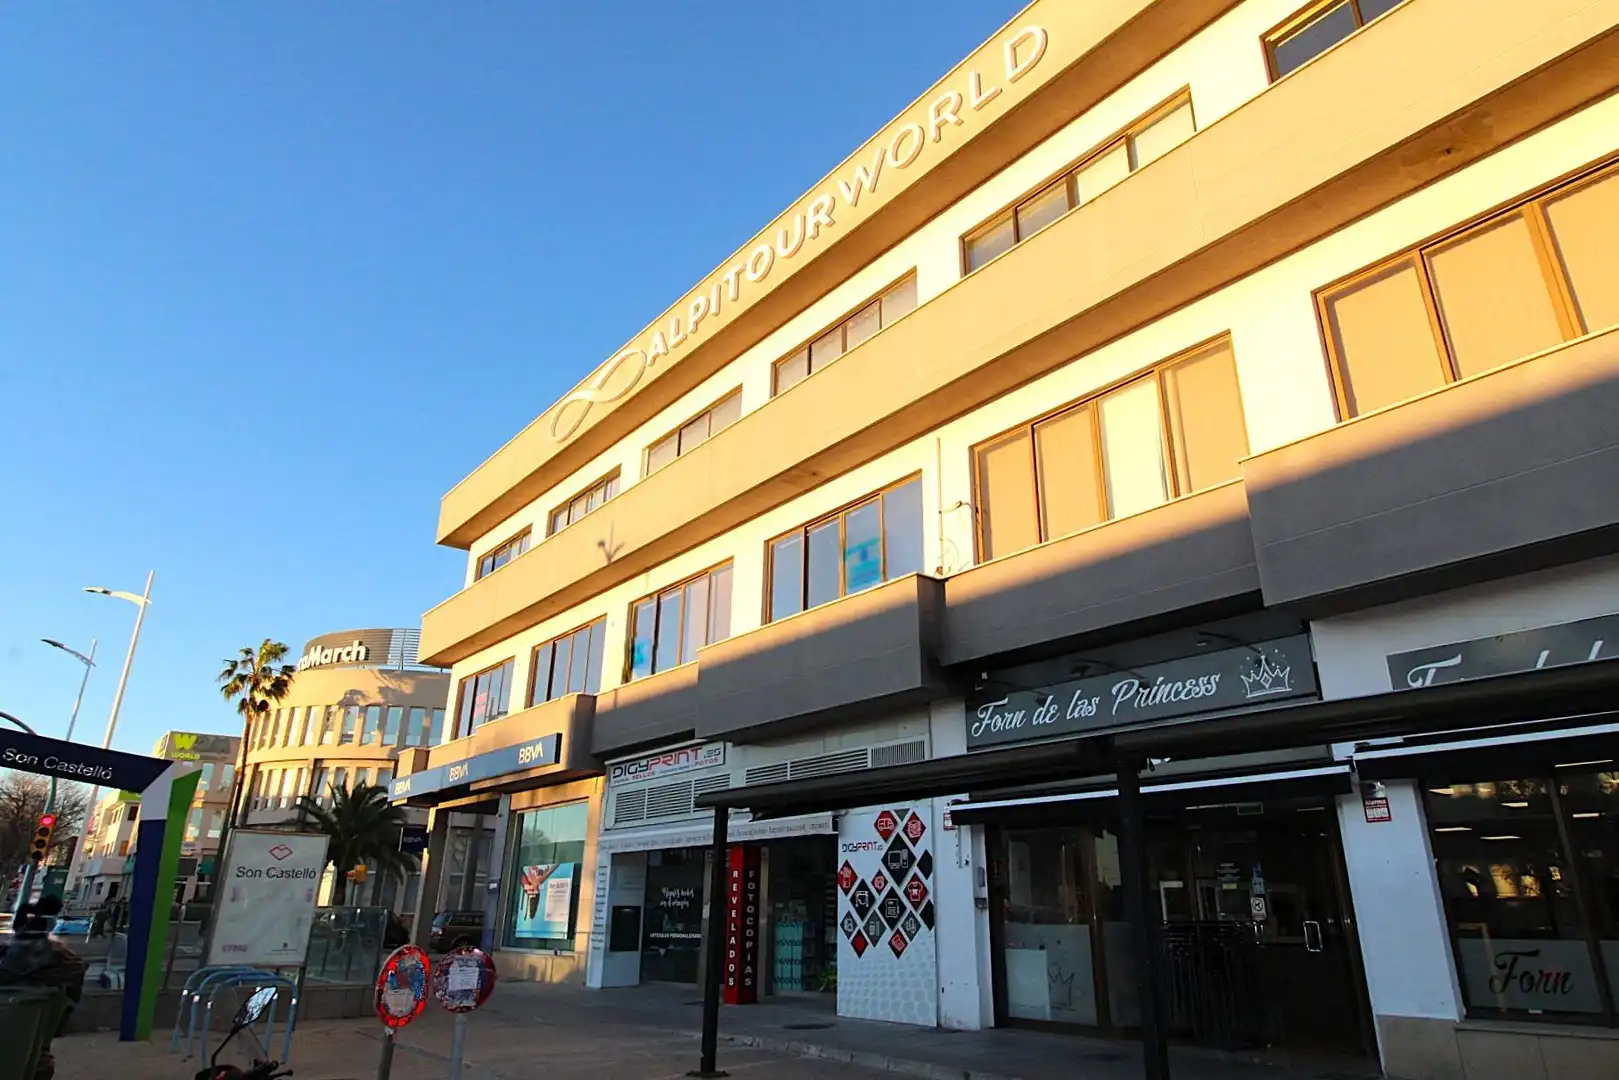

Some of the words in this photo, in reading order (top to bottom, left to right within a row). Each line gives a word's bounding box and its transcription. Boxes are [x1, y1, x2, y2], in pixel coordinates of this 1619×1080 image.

[970, 697, 1027, 737] Forn
[1032, 695, 1060, 726] de
[1066, 689, 1101, 720] las
[1111, 671, 1222, 716] Princess
[2, 747, 39, 765] Son
[43, 755, 113, 780] Castelló
[172, 751, 200, 760] WORLD
[518, 741, 544, 764] BBVA
[449, 762, 469, 782] BBVA
[394, 778, 411, 795] BBVA
[236, 866, 262, 878] Son
[266, 866, 317, 879] Castelló
[728, 870, 739, 987] REVELADOS
[745, 870, 755, 987] FOTOCOPIAS
[1488, 948, 1575, 996] Forn
